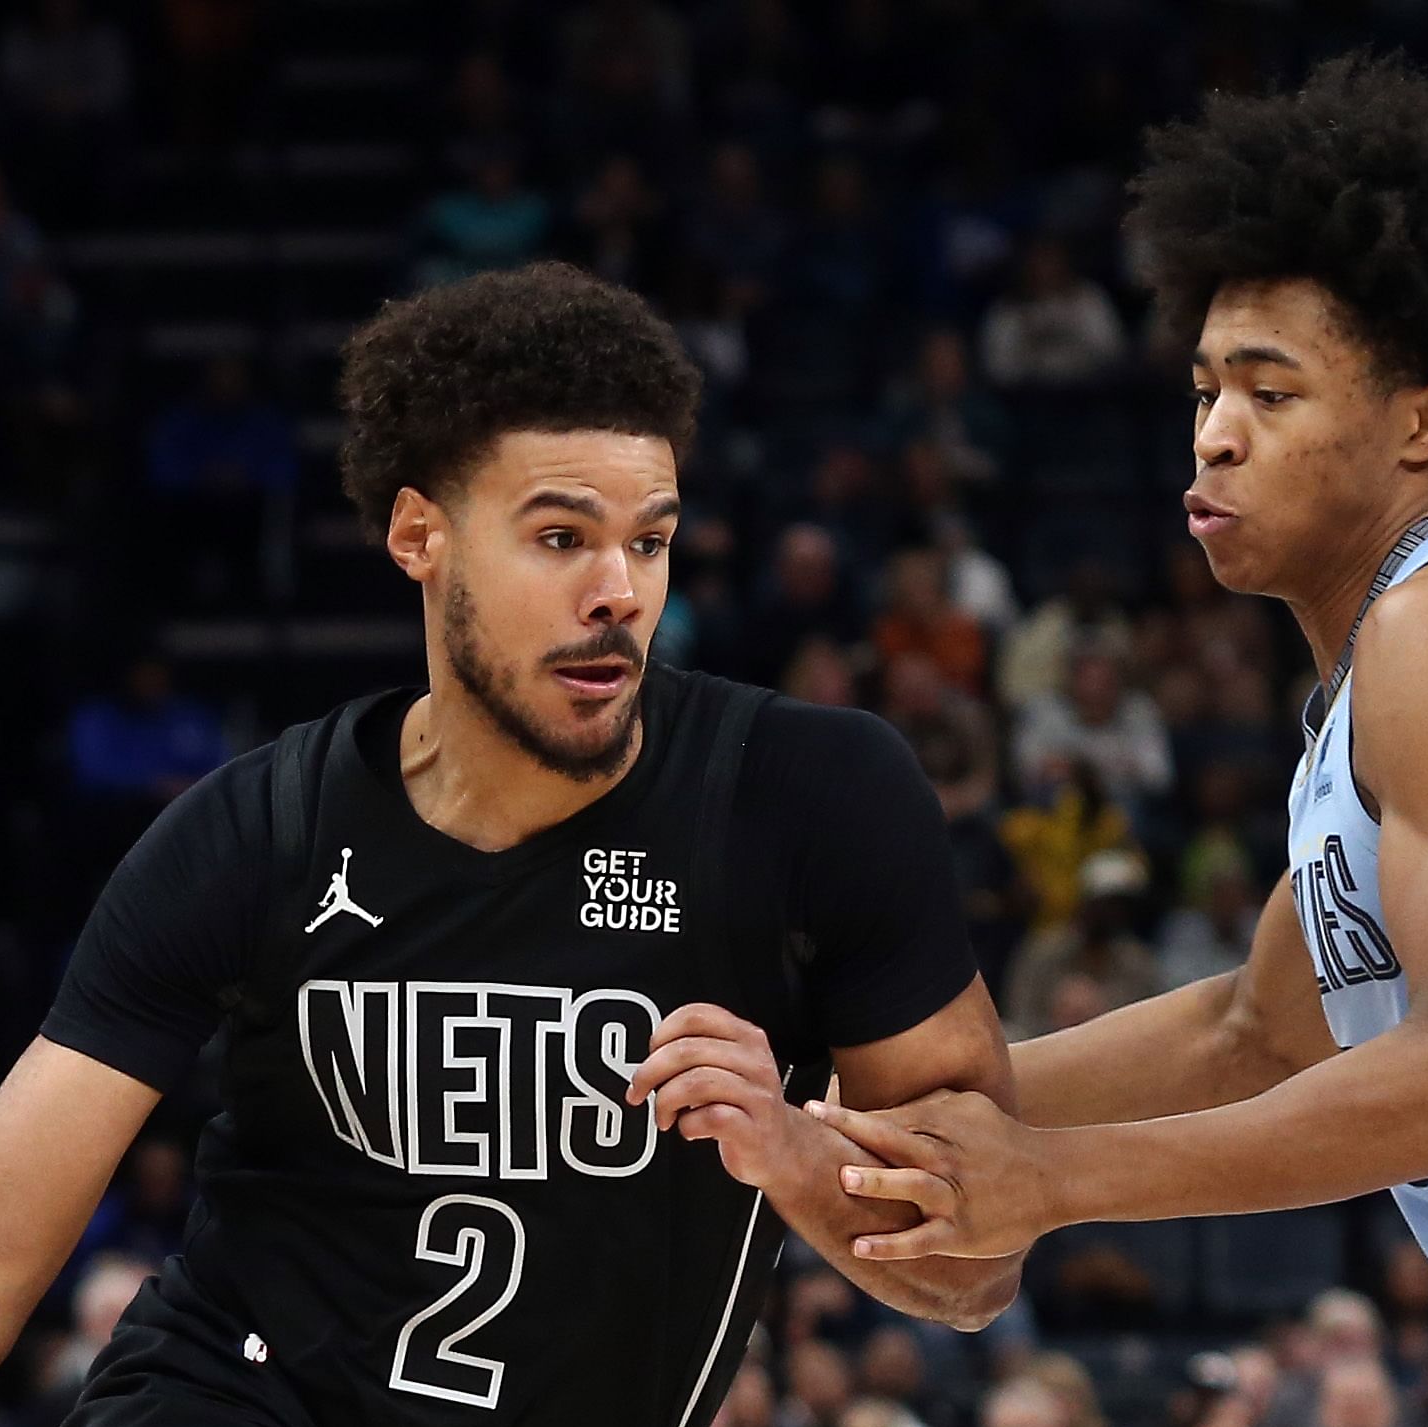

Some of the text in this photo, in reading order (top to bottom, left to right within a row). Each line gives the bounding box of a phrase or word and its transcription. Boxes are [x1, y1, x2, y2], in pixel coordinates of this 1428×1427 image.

[584, 849, 647, 875] GET
[583, 875, 676, 905] YOUR
[580, 902, 680, 932] GUIDE
[298, 980, 661, 1180] NETS
[389, 1193, 526, 1409] 2
